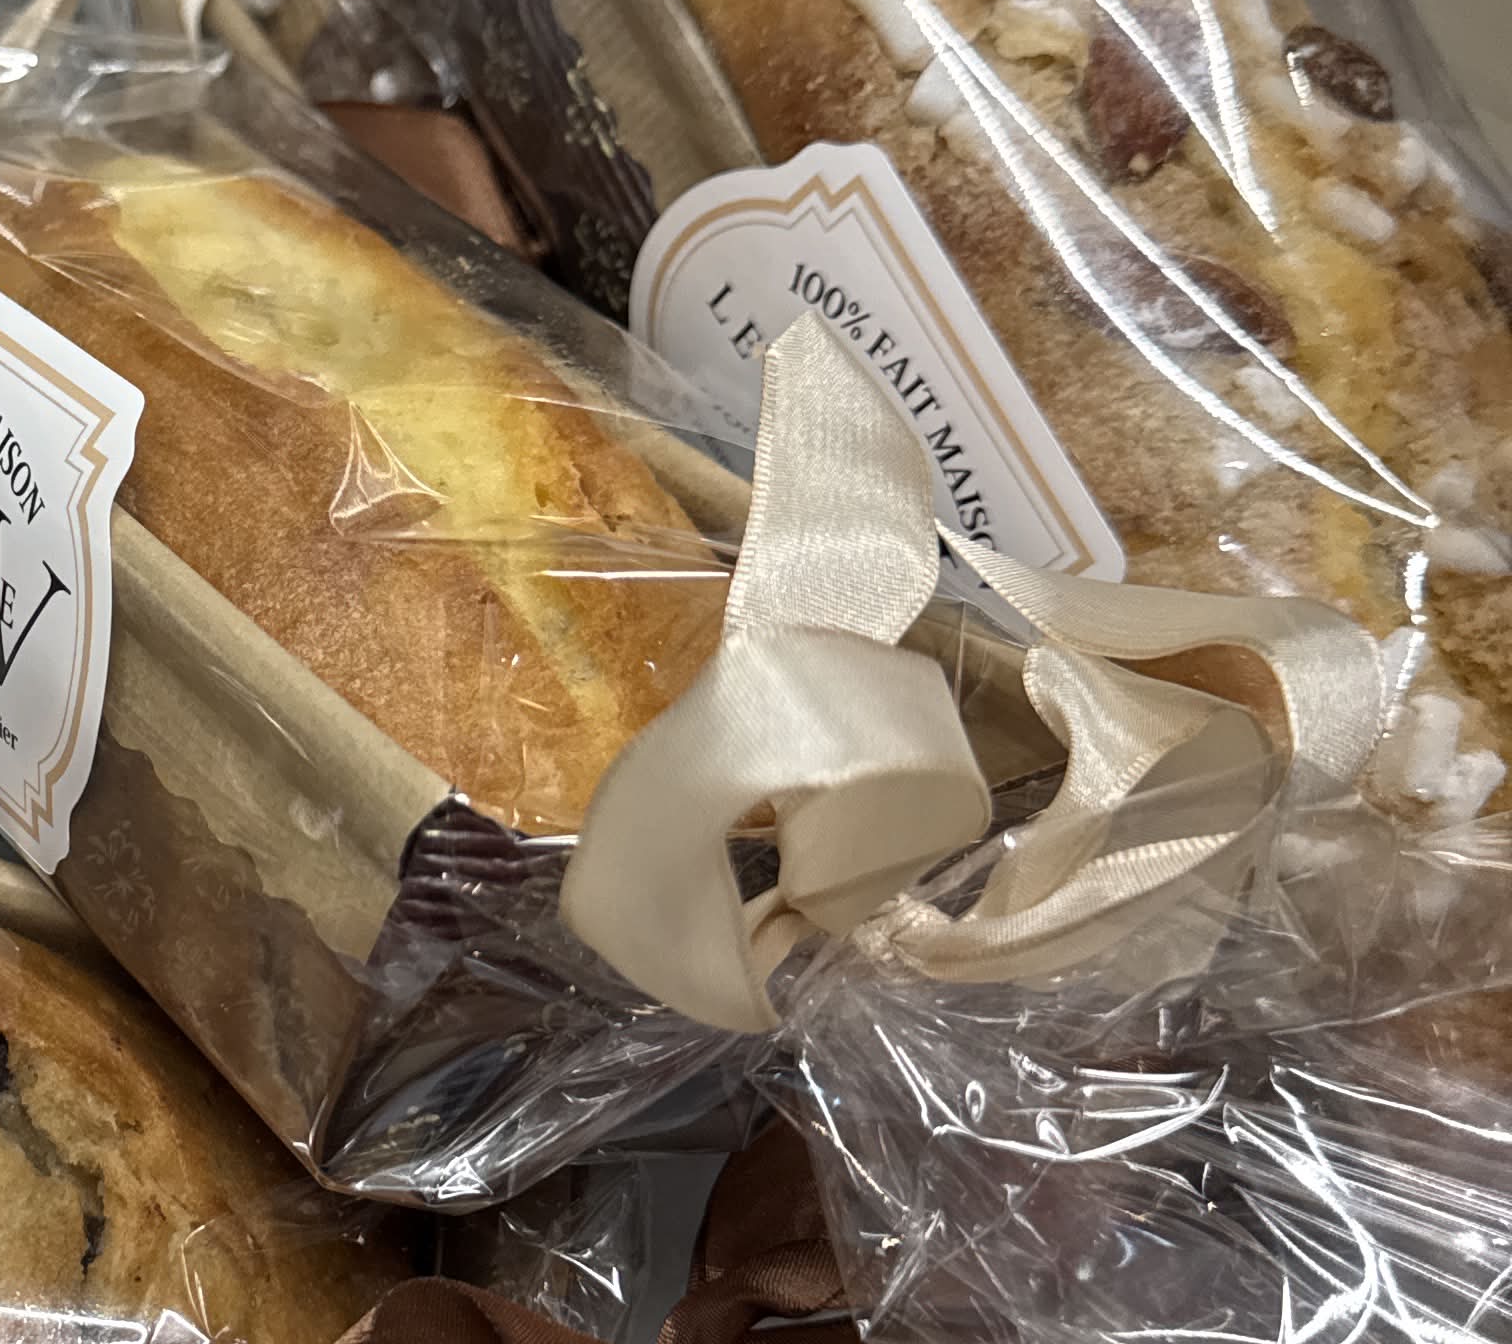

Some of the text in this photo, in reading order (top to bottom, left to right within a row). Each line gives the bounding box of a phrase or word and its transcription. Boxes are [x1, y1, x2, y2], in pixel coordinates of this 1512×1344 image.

[705, 281, 770, 360] LE
[789, 262, 872, 341] 100%
[864, 330, 941, 421] FAIT
[926, 423, 997, 551] MAIS
